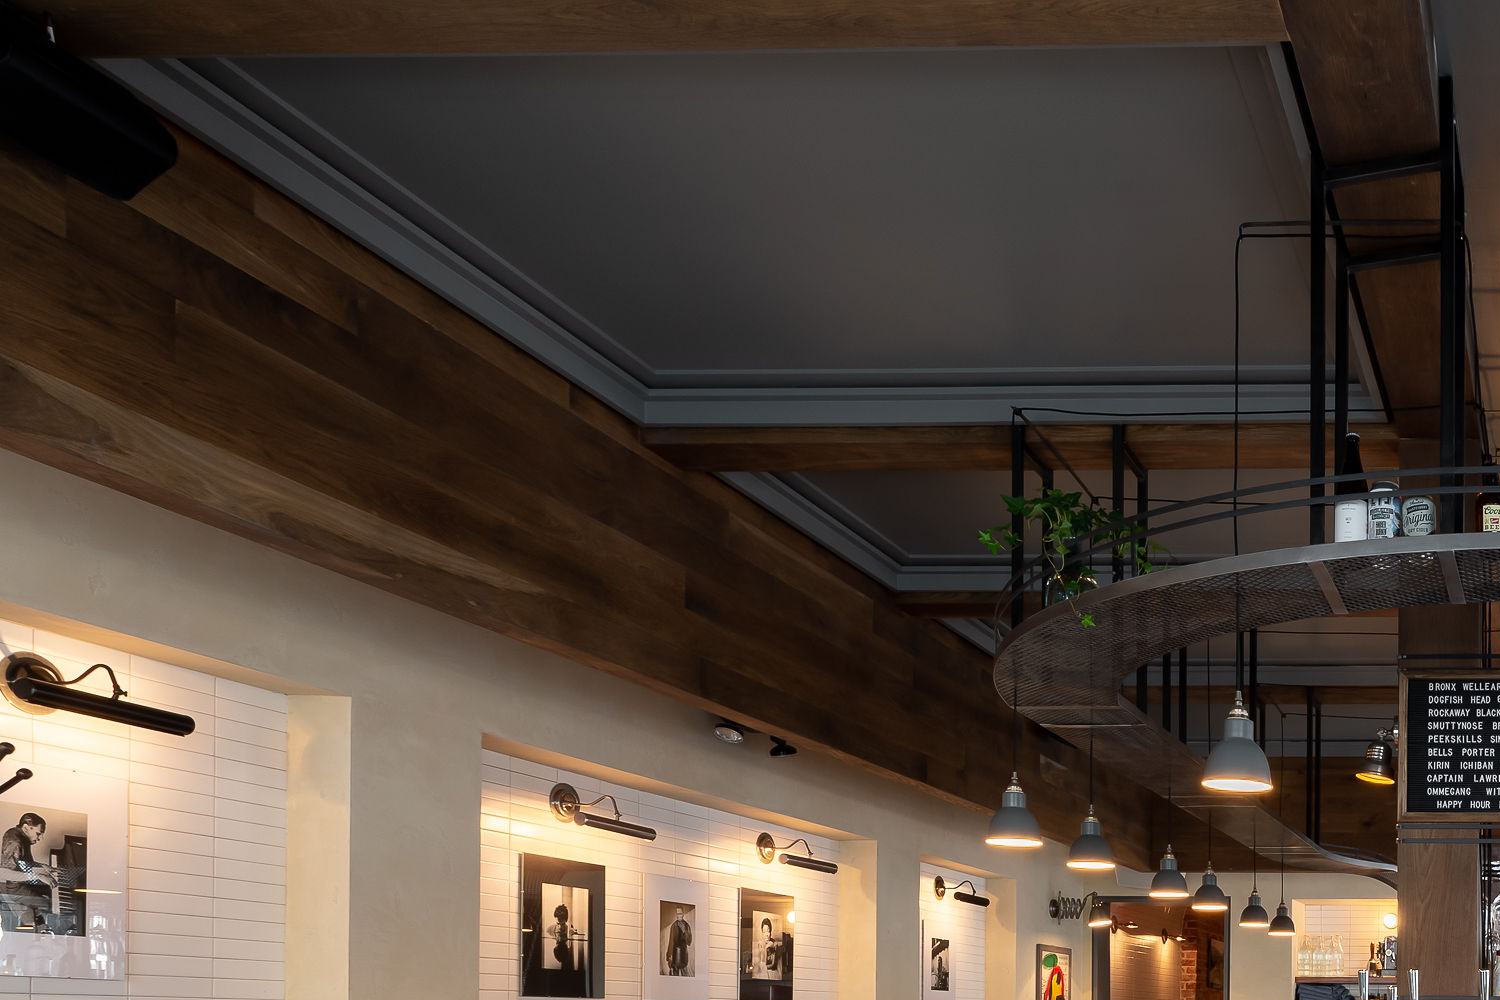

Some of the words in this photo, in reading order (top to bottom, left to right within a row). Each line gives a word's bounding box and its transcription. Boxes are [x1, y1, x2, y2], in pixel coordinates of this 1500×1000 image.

[1403, 511, 1434, 528] Origina
[1428, 682, 1457, 692] BRONX
[1428, 695, 1463, 705] DOGFISH
[1470, 695, 1491, 705] HEAD
[1428, 708, 1471, 718] ROCKAWAY
[1427, 721, 1484, 731] SMUTTYNOSE
[1427, 734, 1483, 744] PEEKSKILLS
[1427, 747, 1454, 757] BELLS
[1461, 747, 1496, 757] PORTER
[1427, 761, 1450, 770] KIRIN
[1460, 761, 1494, 770] ICHIBAN
[1426, 773, 1464, 783] CAPTAIN
[1426, 787, 1472, 796] OMMEGANG
[1436, 800, 1463, 809] HAPPY
[1469, 800, 1491, 809] HOUR
